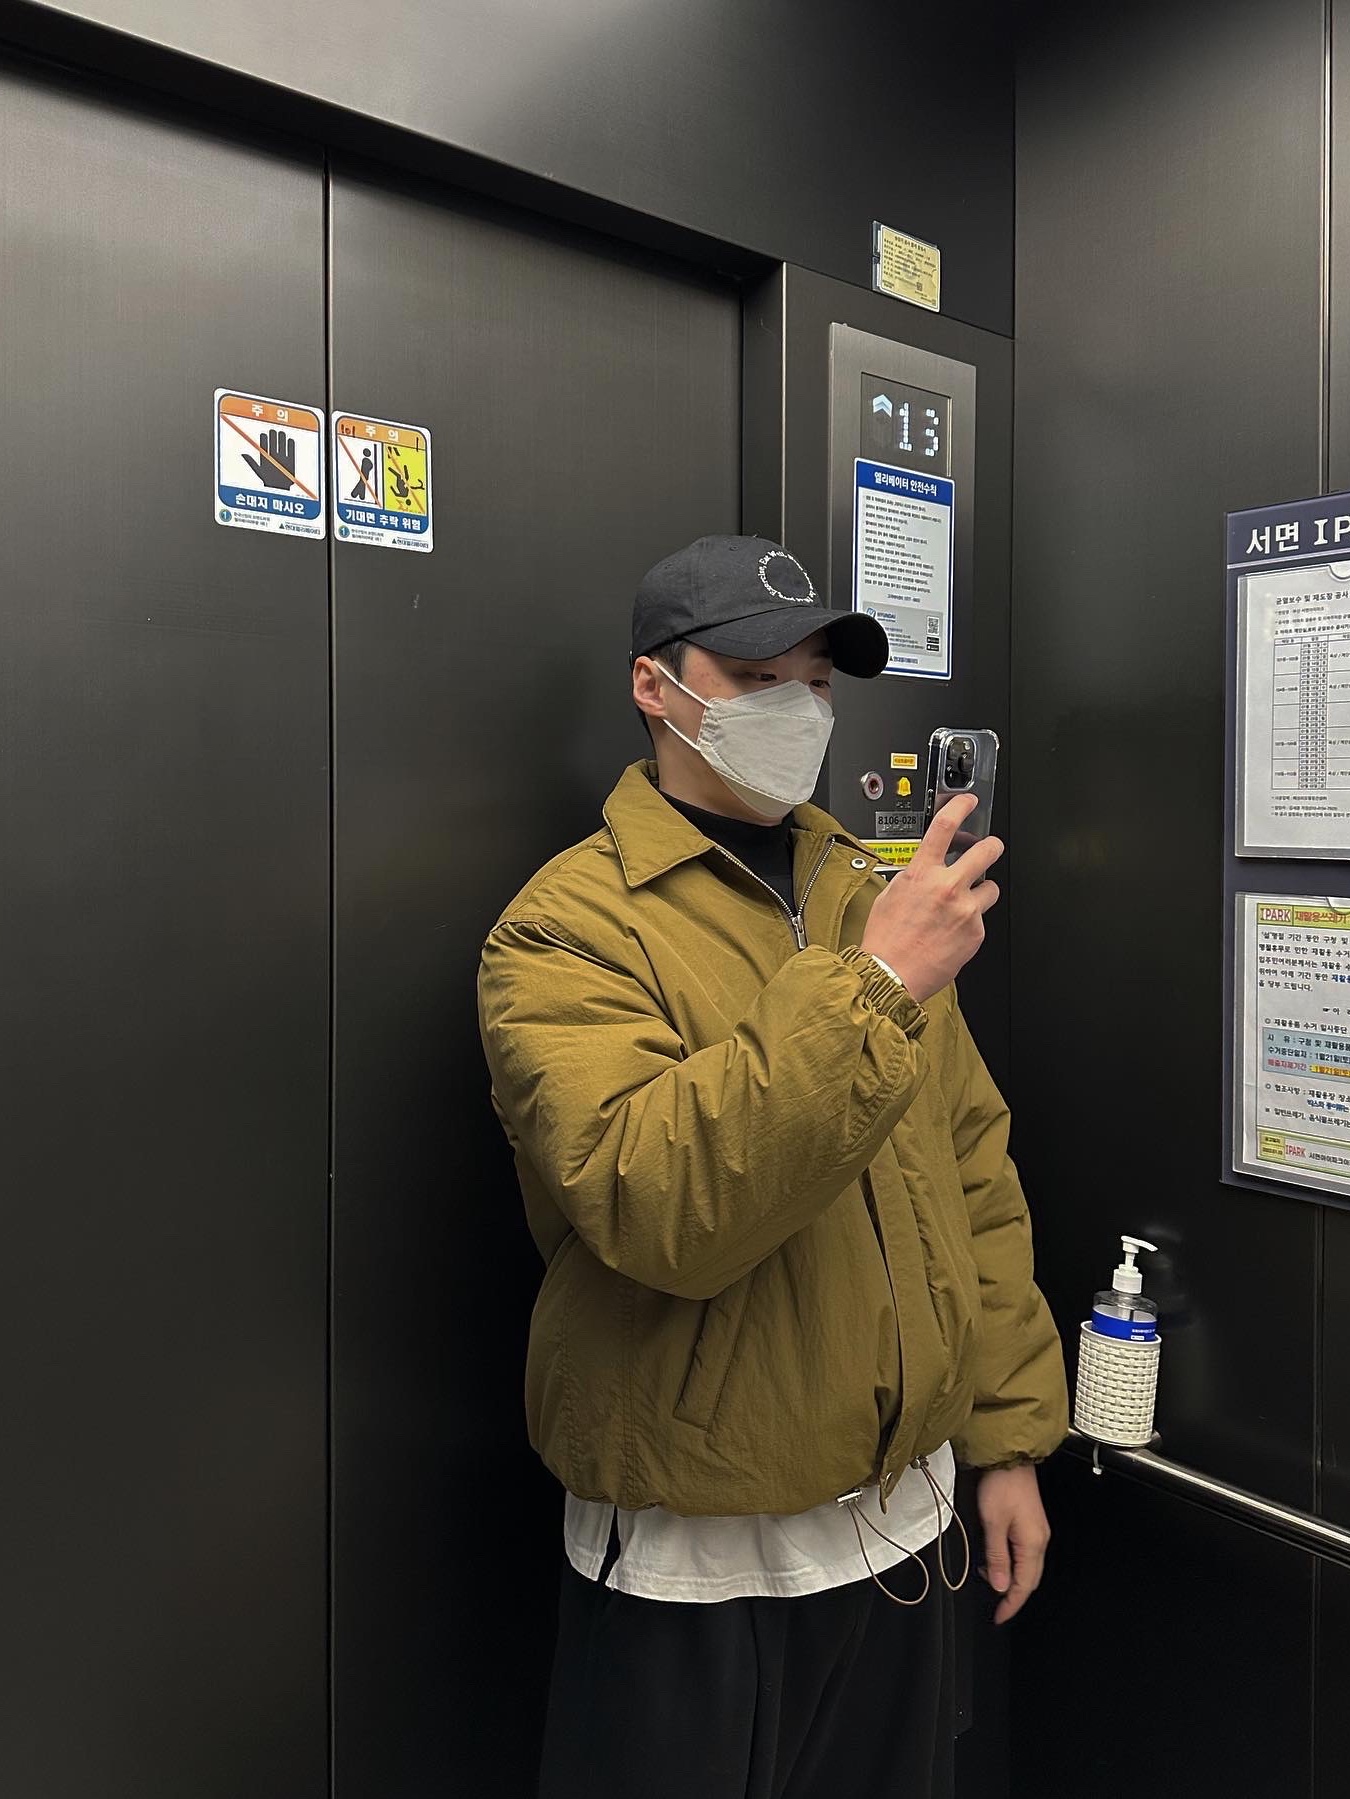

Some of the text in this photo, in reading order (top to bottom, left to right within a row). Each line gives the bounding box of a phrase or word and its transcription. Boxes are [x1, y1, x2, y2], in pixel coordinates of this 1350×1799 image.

[251, 404, 289, 422] 주 의
[365, 425, 399, 442] 주 의
[899, 402, 940, 457] 13
[874, 471, 937, 497] 엘리베이터 안전수칙
[235, 493, 305, 515] 손대지 마시오
[345, 509, 421, 531] 기대면 추락 위험
[1245, 521, 1300, 555] 서면
[878, 815, 918, 825] 8106-028
[1260, 907, 1292, 923] IPARK
[1288, 933, 1302, 942] 기간
[1305, 934, 1320, 943] 동안
[1323, 936, 1337, 945] 구청
[1341, 937, 1348, 945] 및
[1294, 947, 1308, 955] 인한
[1311, 948, 1332, 957] 재활용
[1335, 949, 1350, 958] 수거
[1321, 961, 1342, 970] 재활용
[1259, 968, 1278, 976] 위하여
[1298, 971, 1312, 980] 기간
[1315, 973, 1328, 981] 동안
[1283, 983, 1313, 992] 드립니다.
[1274, 1018, 1348, 1035] 재활용품 수거 일시중단
[1298, 1037, 1312, 1047] 구청
[1267, 1046, 1307, 1059] 수거중단일자
[1274, 1084, 1301, 1096] 협조사항
[1285, 1144, 1307, 1158] IPARK
